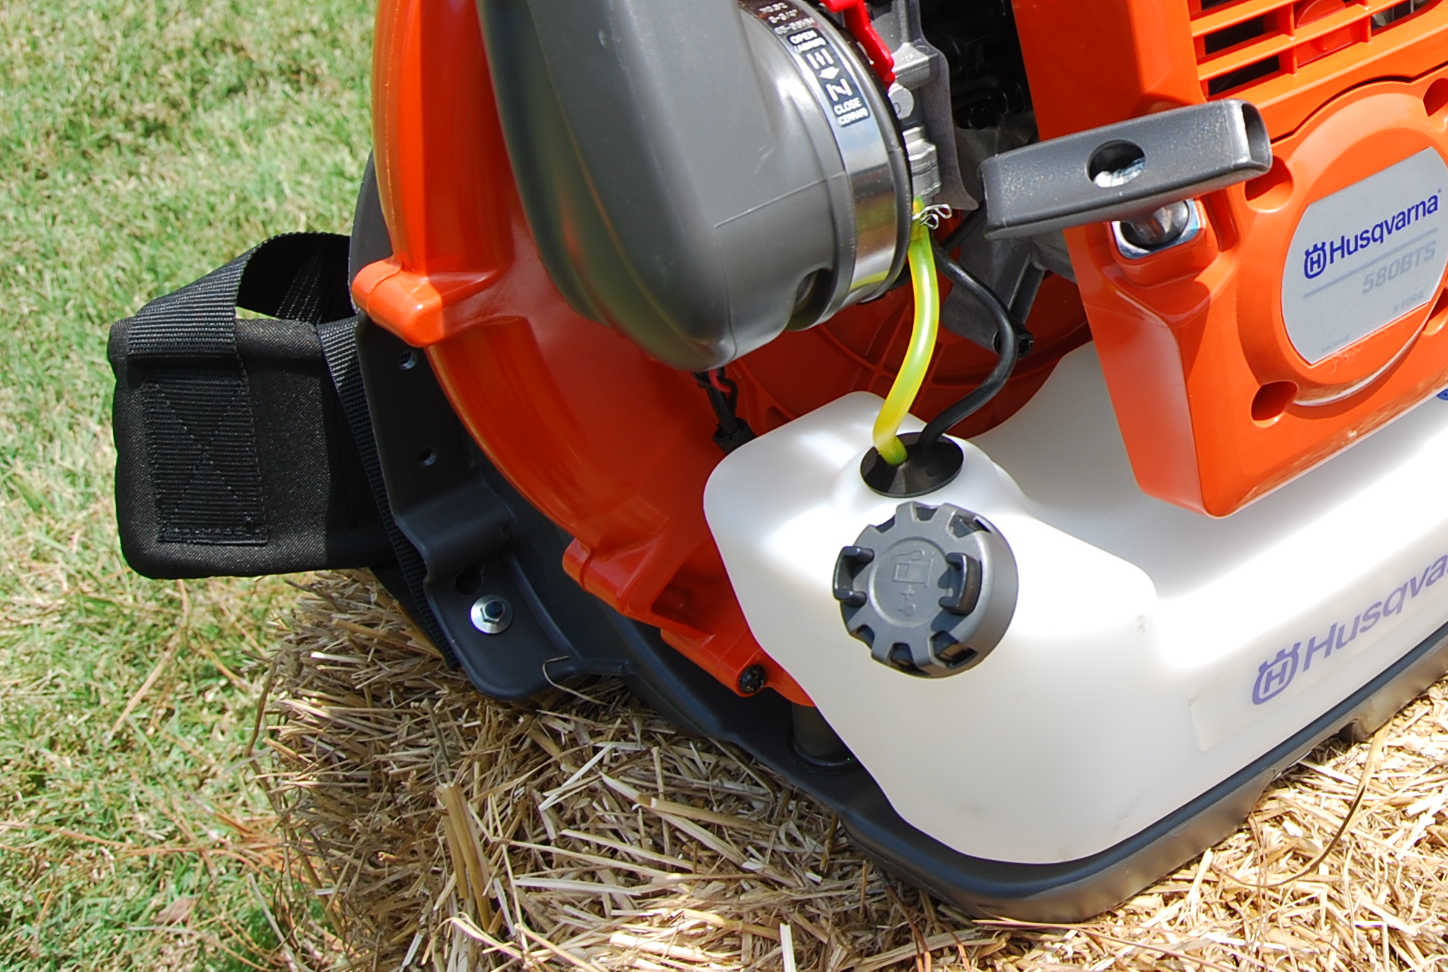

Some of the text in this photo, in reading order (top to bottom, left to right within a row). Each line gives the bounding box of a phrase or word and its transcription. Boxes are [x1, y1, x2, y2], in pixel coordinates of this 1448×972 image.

[790, 30, 818, 44] OPEN
[834, 98, 863, 115] CLOSE
[1329, 194, 1439, 265] Husqvarna
[1362, 240, 1436, 294] 580BTS
